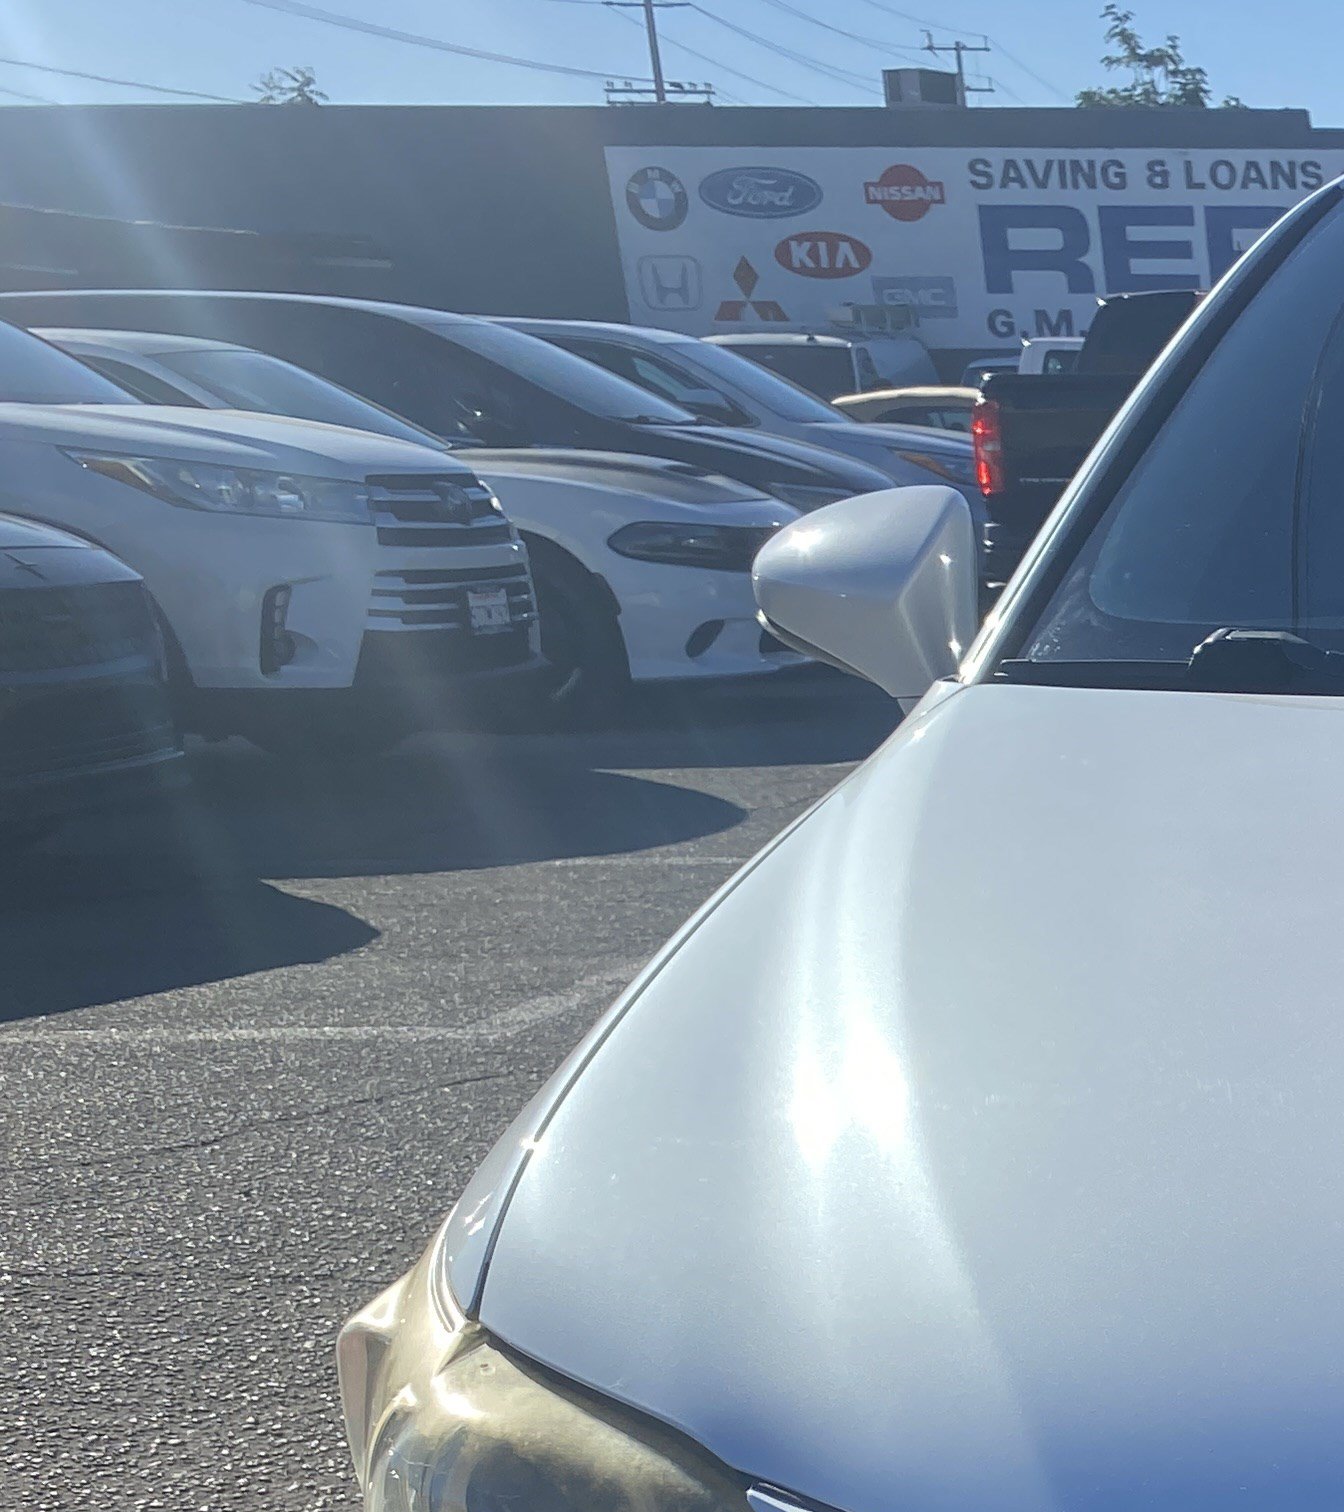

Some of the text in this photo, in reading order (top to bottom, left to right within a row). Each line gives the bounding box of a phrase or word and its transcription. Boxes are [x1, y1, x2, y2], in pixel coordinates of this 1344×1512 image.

[967, 158, 1324, 191] SAVING & LOANS
[868, 185, 942, 201] NISSAN
[789, 240, 860, 269] KIA
